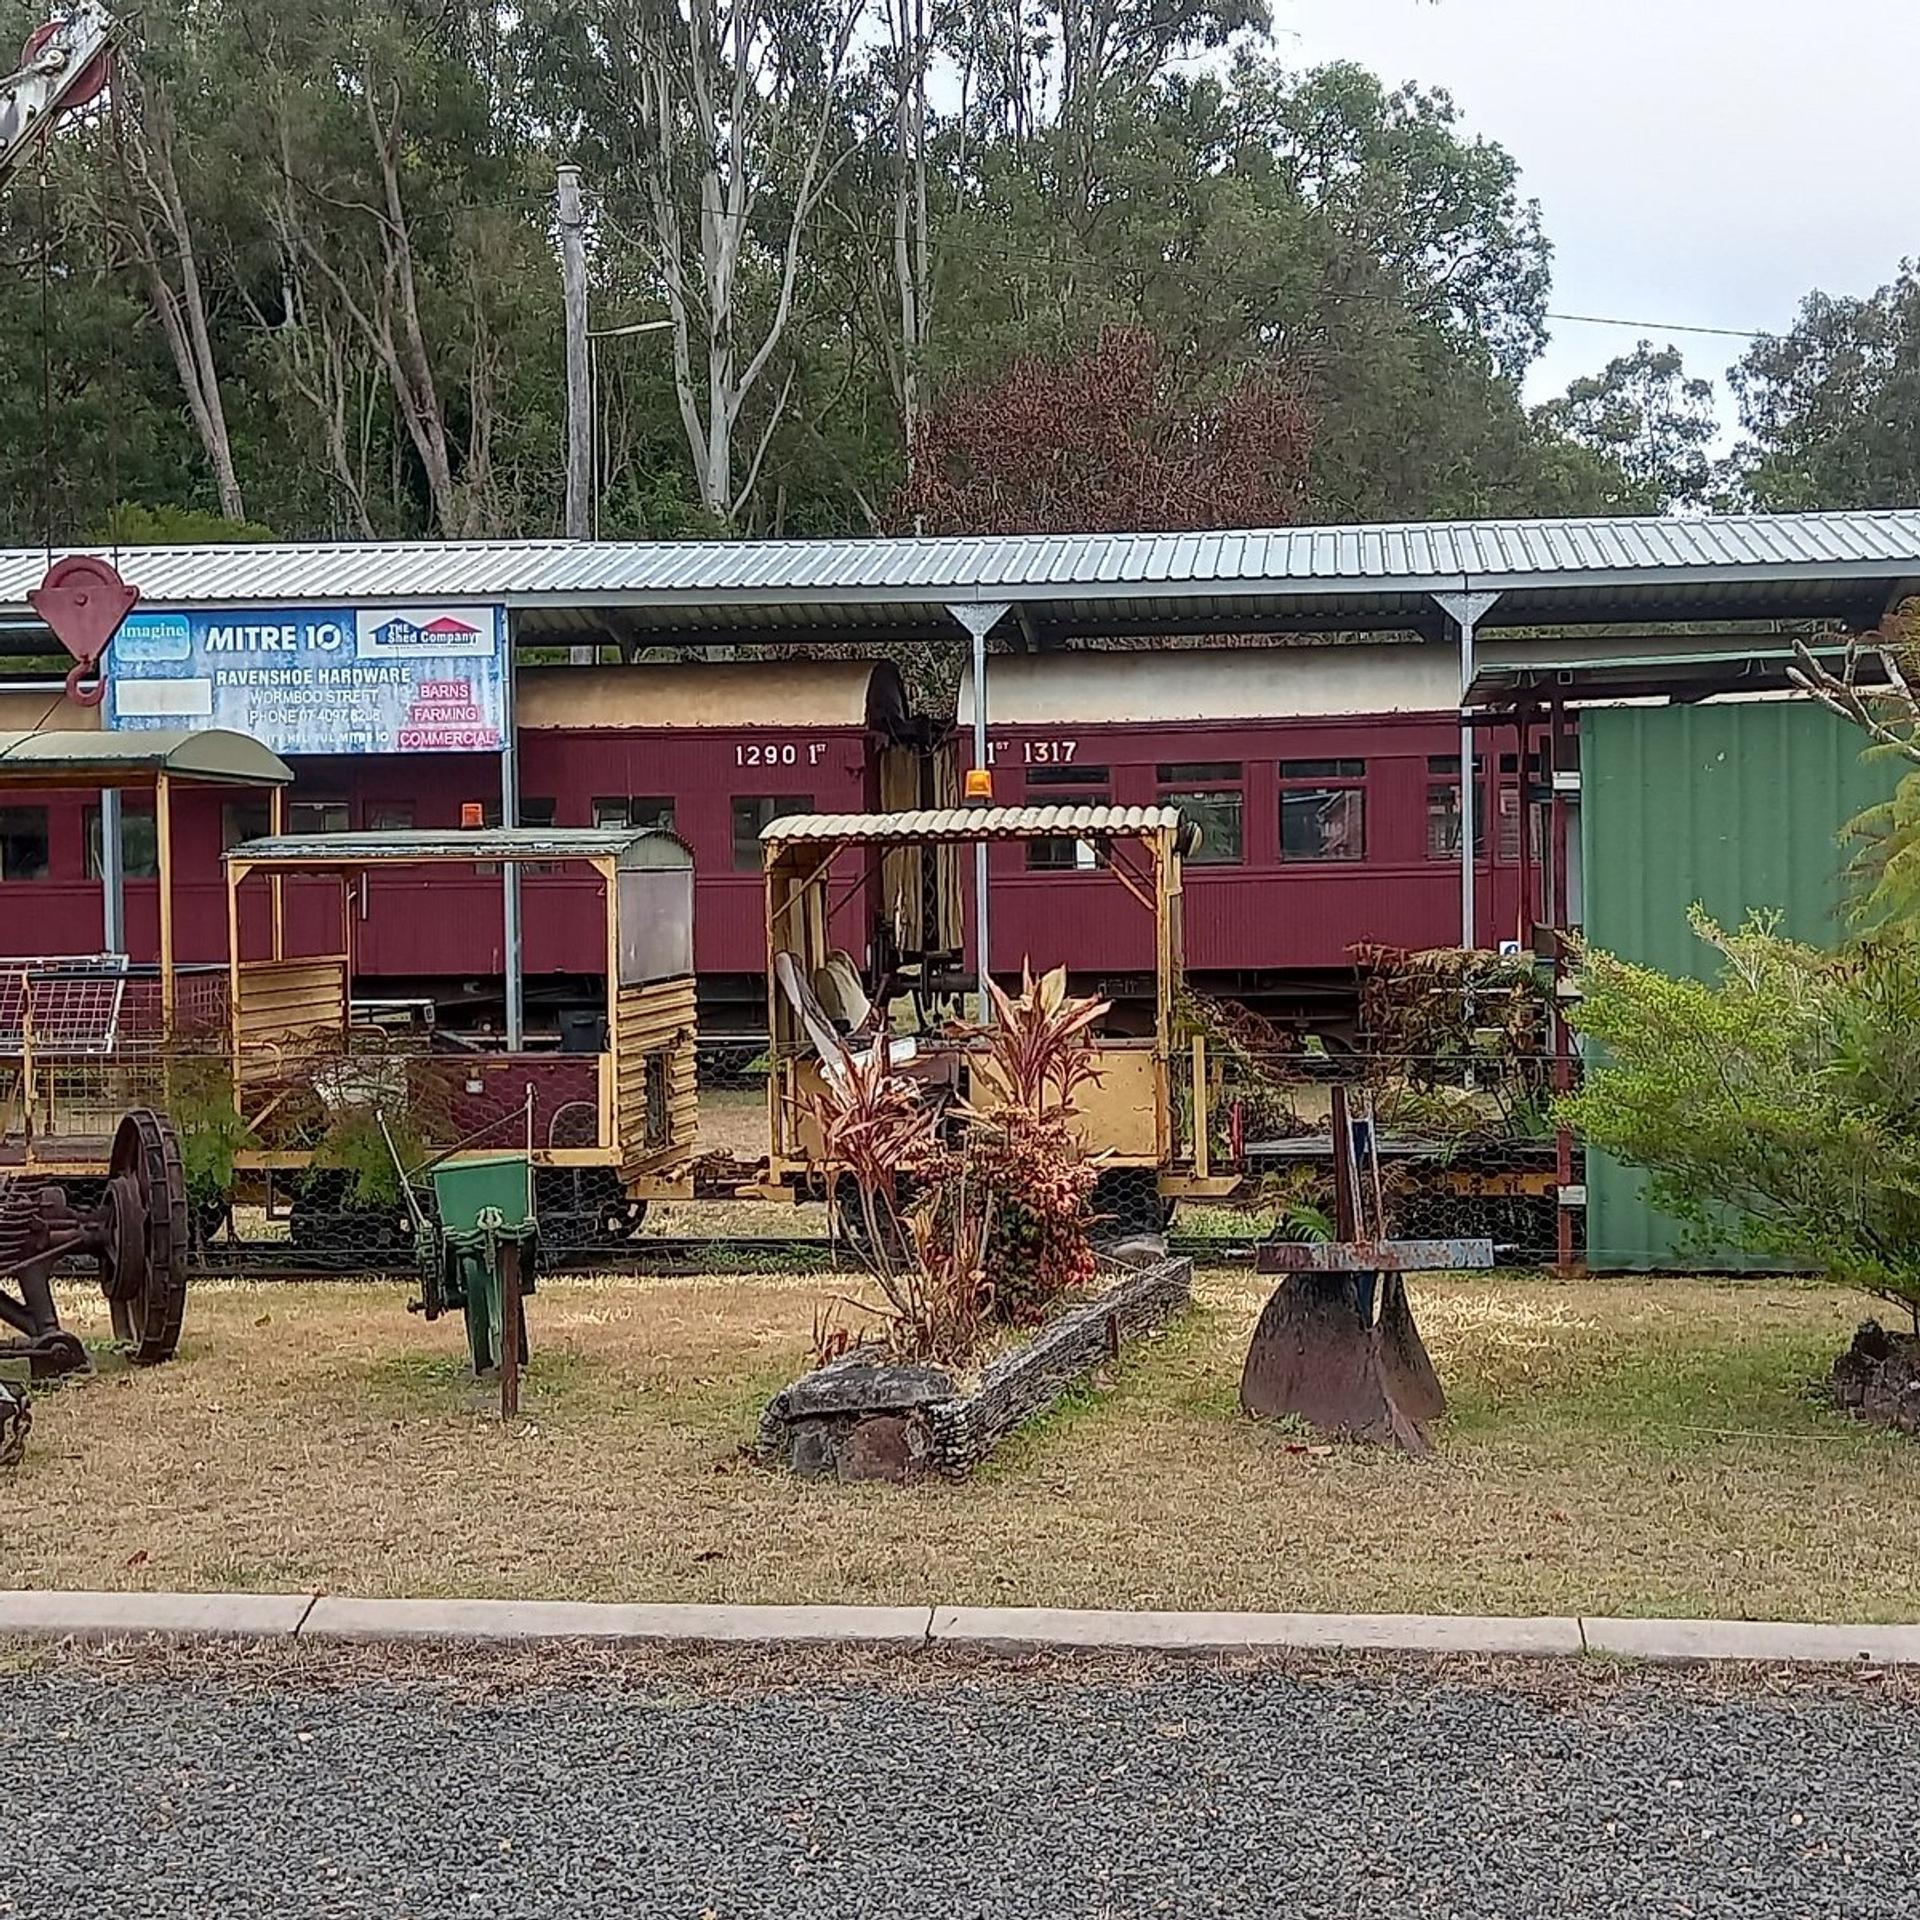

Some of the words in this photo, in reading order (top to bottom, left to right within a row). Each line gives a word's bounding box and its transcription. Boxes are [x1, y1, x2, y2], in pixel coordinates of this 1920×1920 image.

[388, 624, 410, 633] THE
[205, 626, 298, 650] MITRE
[306, 624, 342, 650] 10
[388, 632, 417, 643] Shed
[420, 631, 478, 644] Company
[216, 669, 313, 685] RAVENSHOE
[319, 667, 411, 683] HARDWARE
[327, 689, 379, 703] STREET
[421, 685, 468, 698] BARNS
[250, 709, 298, 723] PHONE
[415, 707, 476, 720] FARMING
[400, 731, 494, 745] COMMERCIAL
[736, 745, 795, 765] 1290
[1024, 742, 1077, 763] 1317
